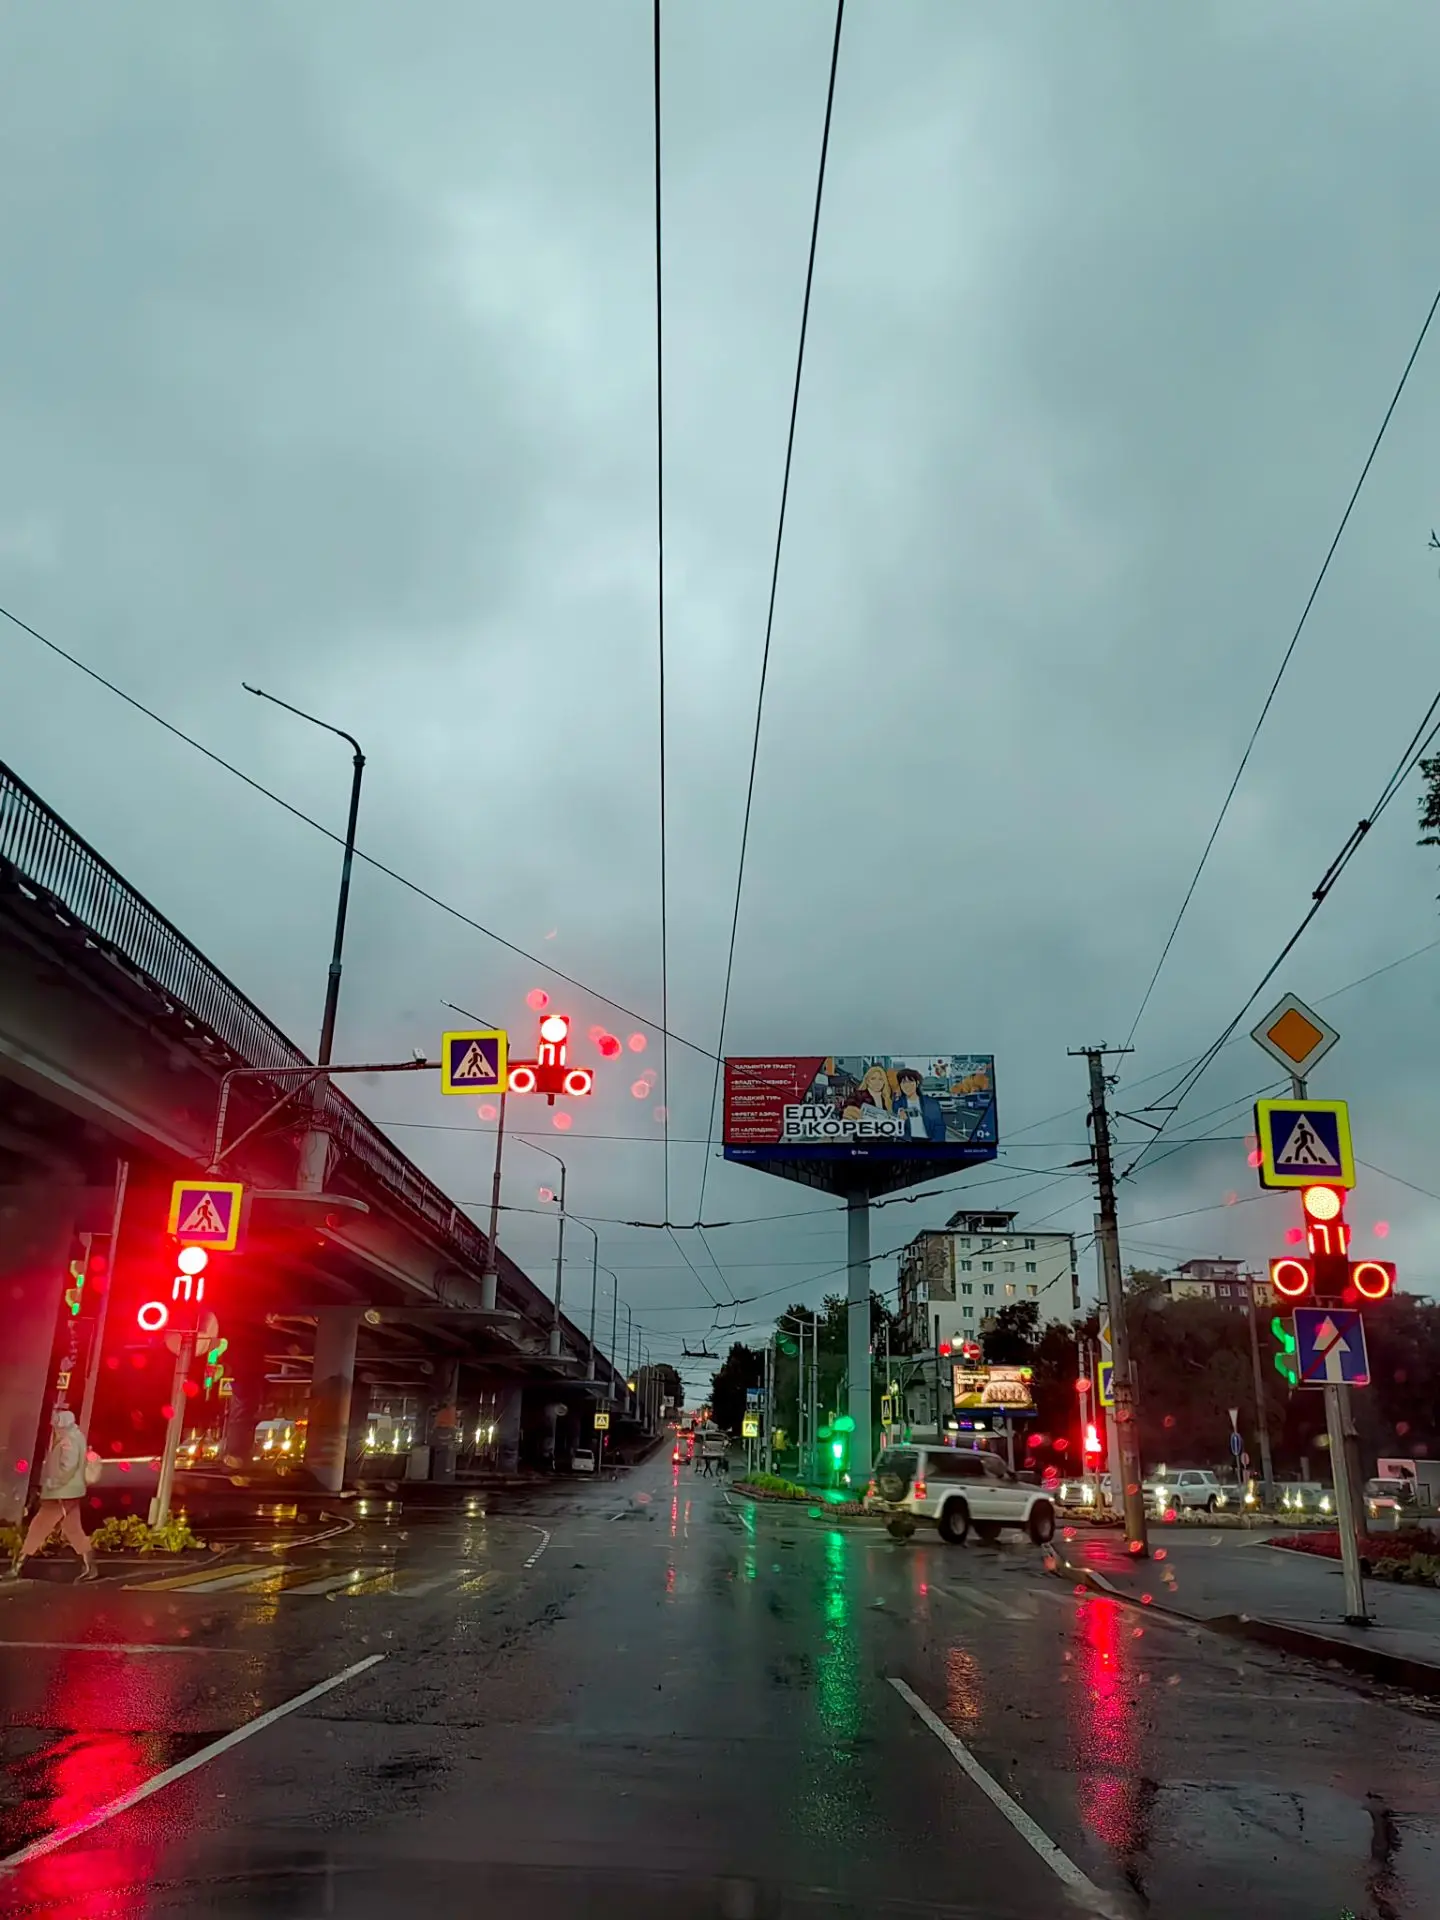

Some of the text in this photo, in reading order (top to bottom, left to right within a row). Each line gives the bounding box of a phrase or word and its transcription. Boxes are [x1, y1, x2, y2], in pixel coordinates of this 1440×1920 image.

[785, 1106, 832, 1121] ЕДУ
[785, 1121, 903, 1135] В КОРЕЮ!
